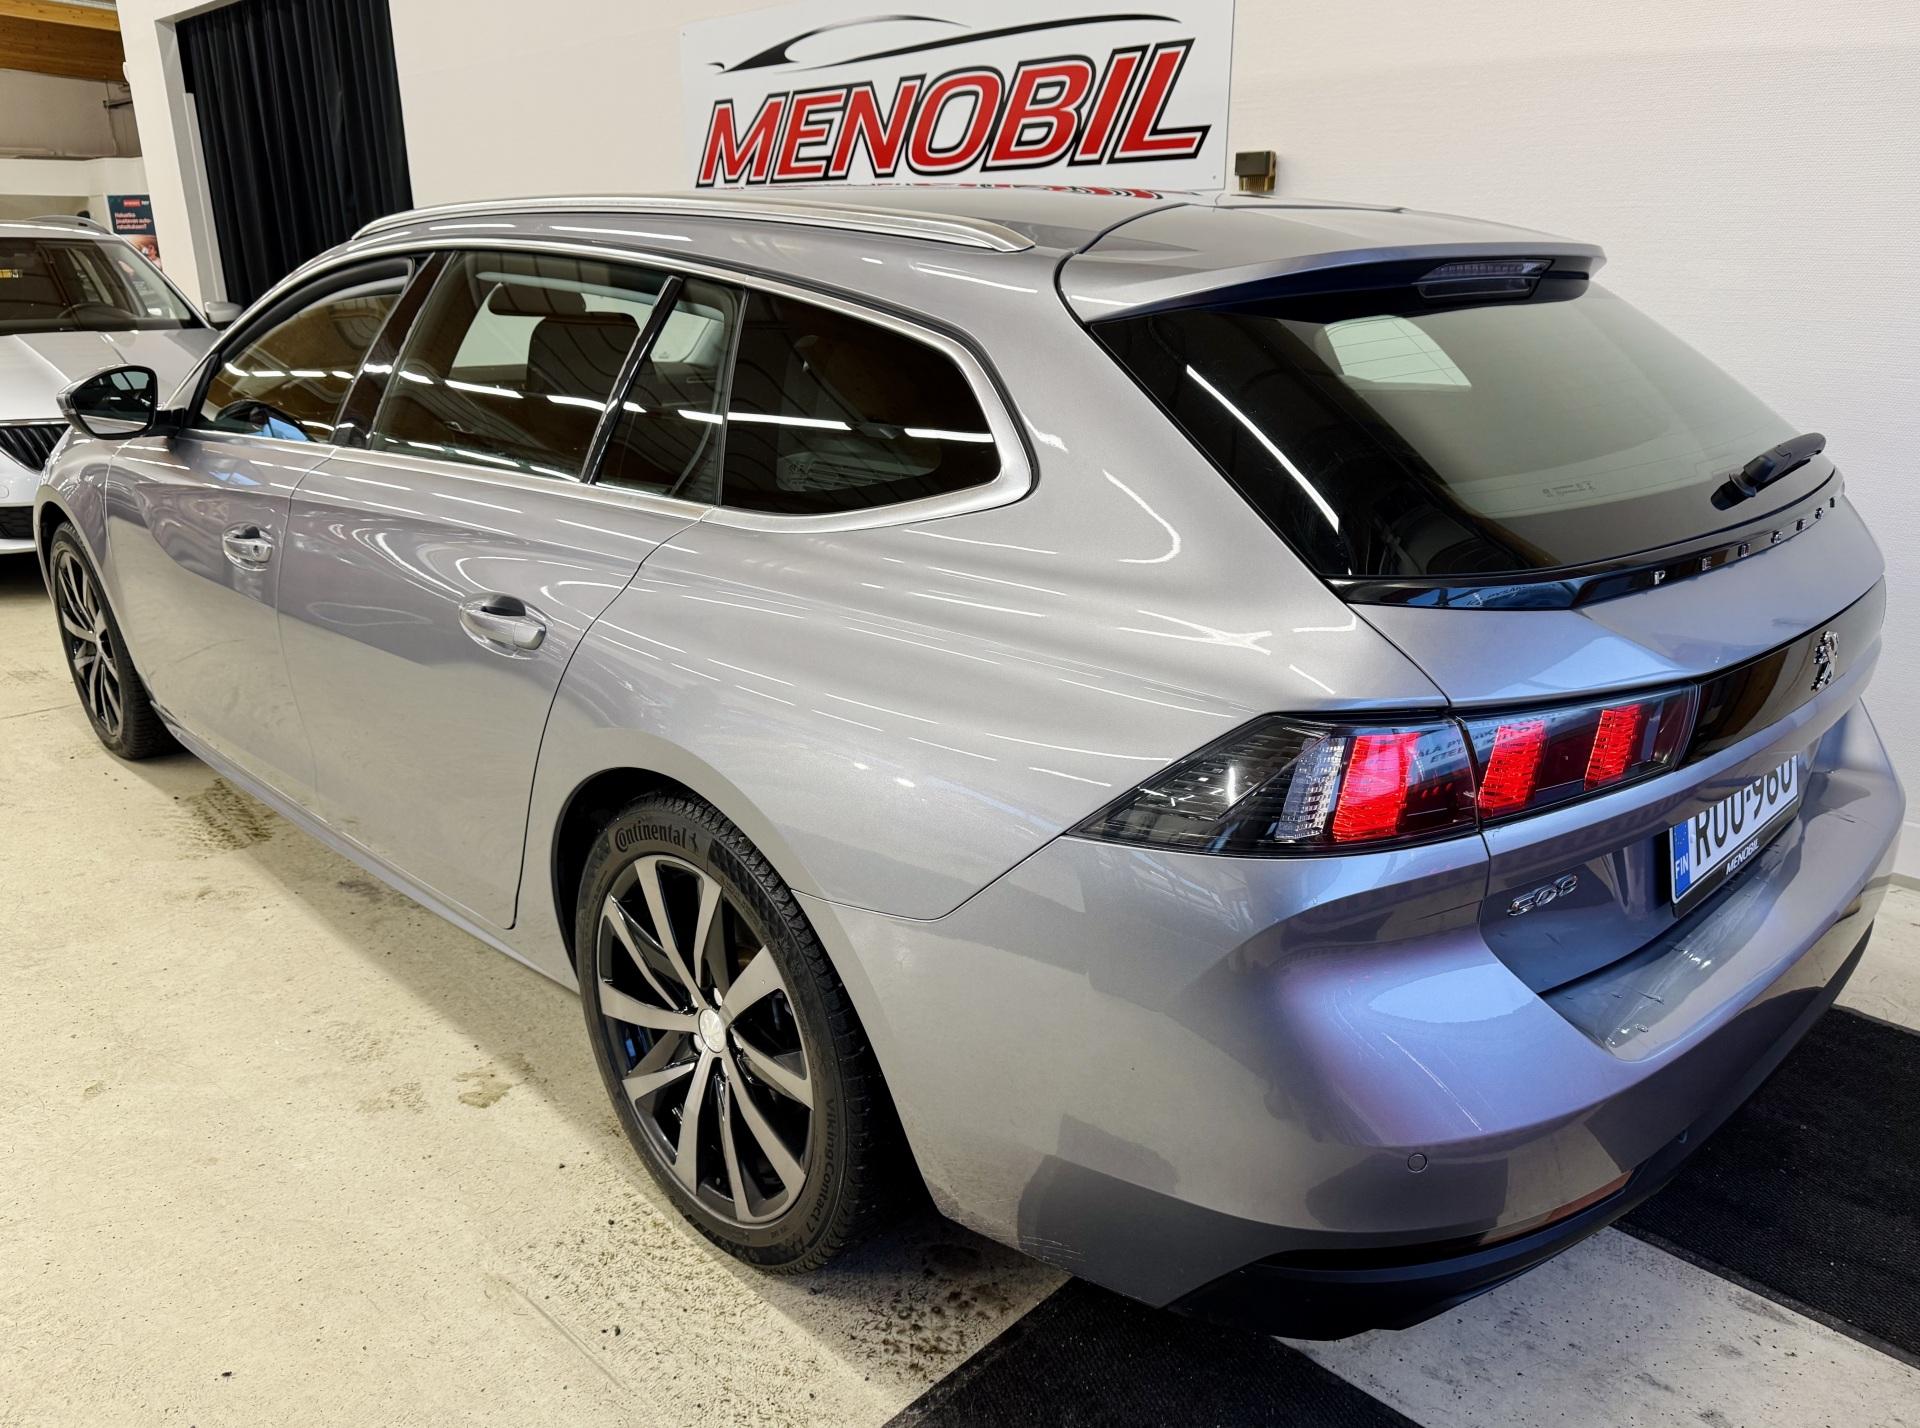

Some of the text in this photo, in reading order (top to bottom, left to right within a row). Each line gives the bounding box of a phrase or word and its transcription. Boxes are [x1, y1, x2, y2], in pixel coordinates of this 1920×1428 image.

[696, 38, 1212, 188] MENOBIL
[615, 819, 687, 852] Continental
[1675, 854, 1689, 879] FIN
[1726, 838, 1760, 875] MENOBIL
